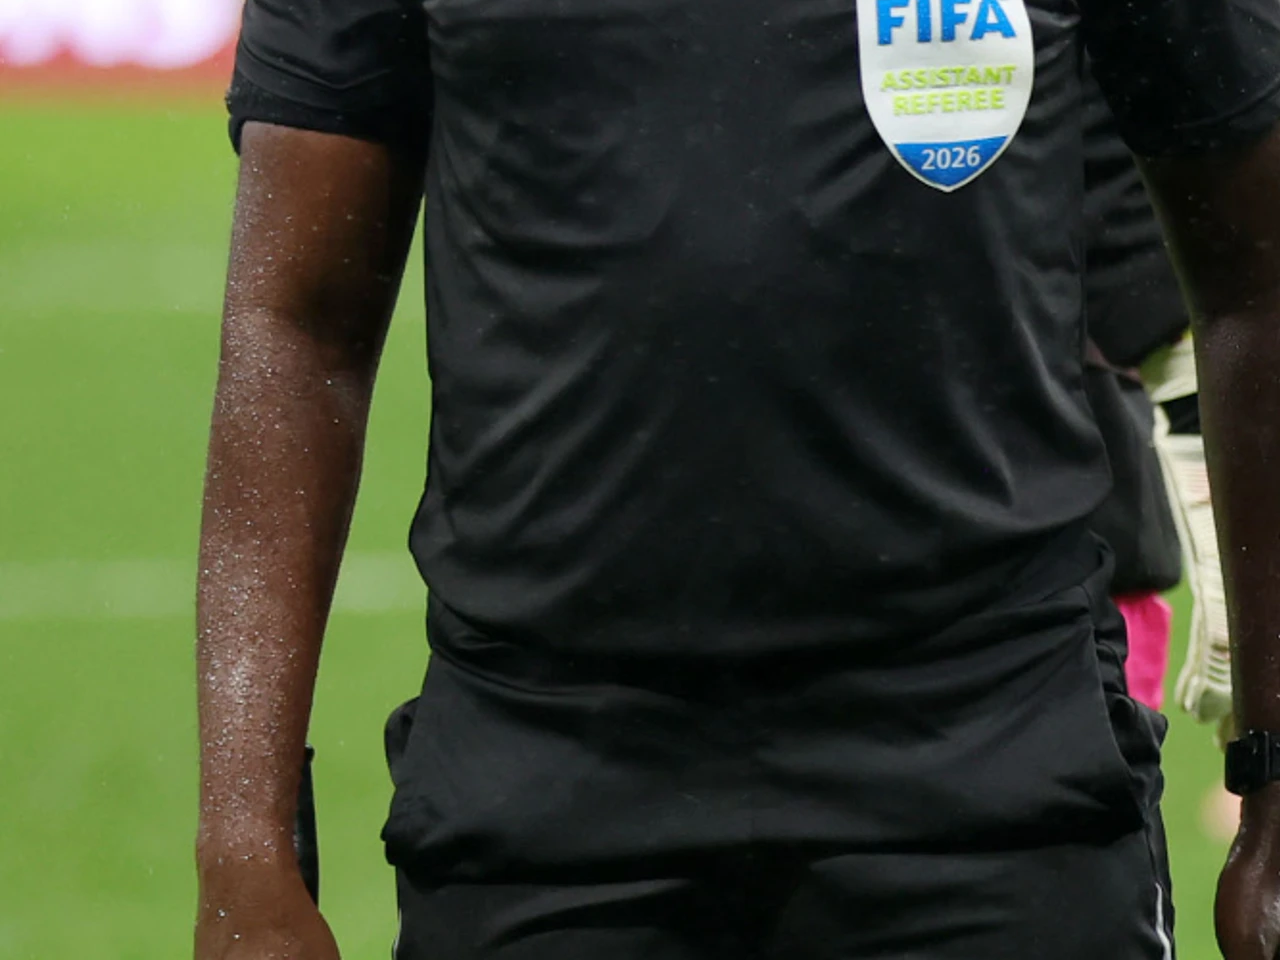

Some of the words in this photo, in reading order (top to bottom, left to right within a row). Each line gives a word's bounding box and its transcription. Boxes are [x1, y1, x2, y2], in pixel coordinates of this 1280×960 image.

[880, 65, 1016, 92] ASSISTANT
[893, 87, 1005, 116] REFEREE
[921, 145, 981, 170] 2026
